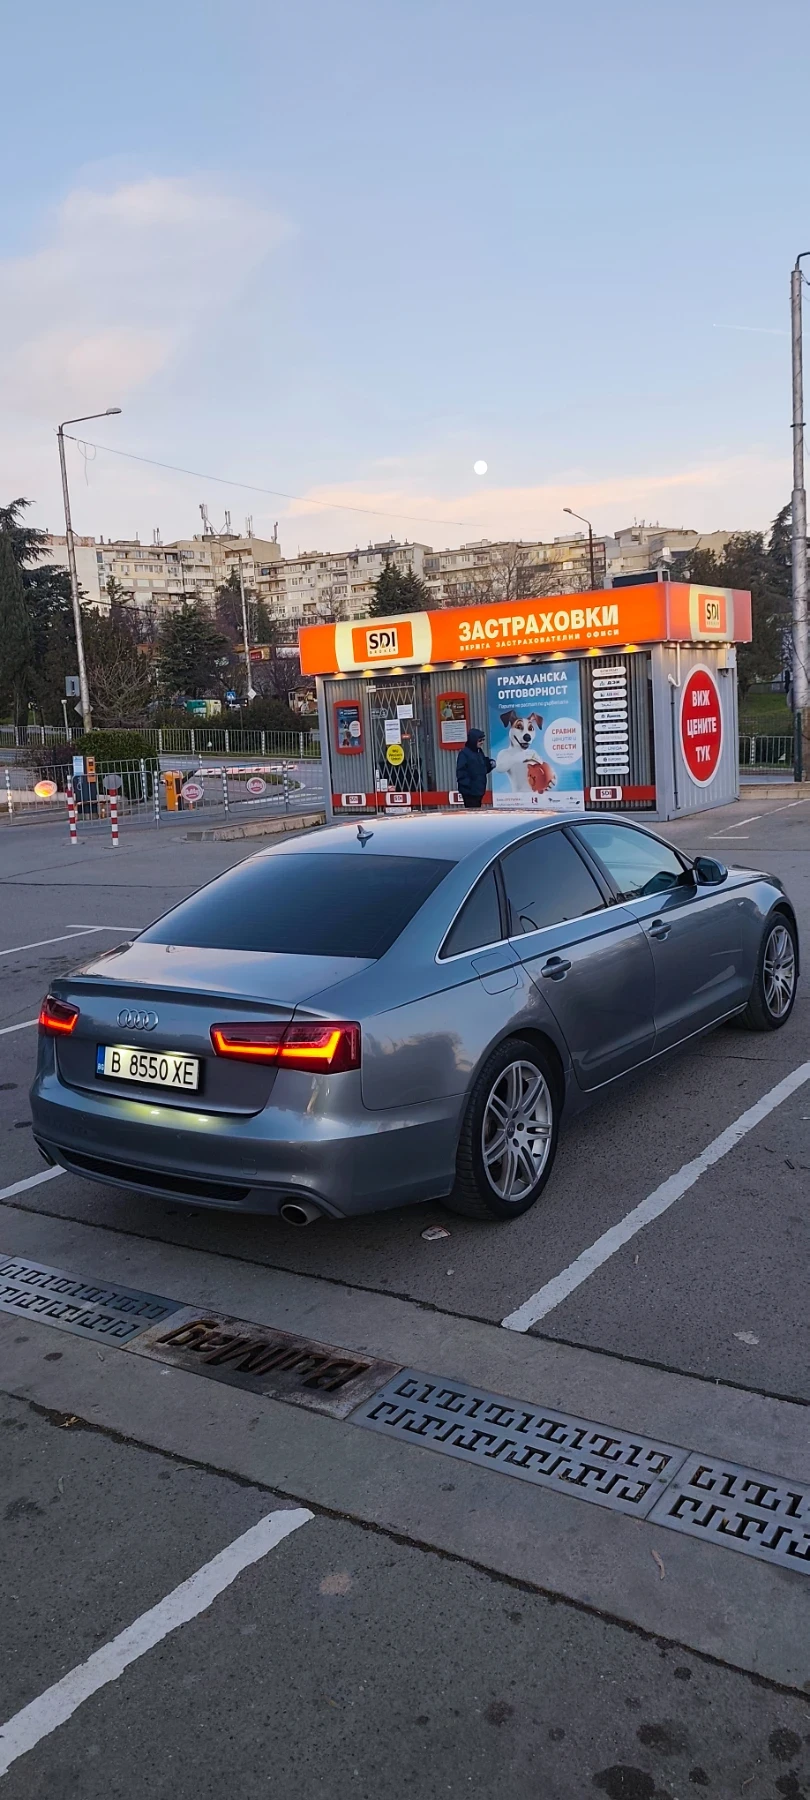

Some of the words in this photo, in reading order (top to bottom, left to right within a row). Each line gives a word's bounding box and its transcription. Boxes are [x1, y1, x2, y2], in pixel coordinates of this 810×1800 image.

[706, 602, 720, 621] SDI
[458, 604, 619, 643] ЗАСТРАХОВКИ
[369, 631, 396, 650] SDI
[459, 642, 491, 652] ВЕРИГА
[495, 633, 581, 648] ЗАСТРАХОВАТЕЛНИ
[586, 629, 619, 639] ОФИСИ
[497, 671, 568, 687] ГРАЖДАНСКА
[497, 685, 568, 700] ОТГОВОРНОСТ
[691, 689, 710, 707] ВИЖ
[551, 727, 576, 735] СРАВНИ
[686, 716, 717, 738] ЦЕНИТЕ
[552, 743, 577, 751] СПЕСТИ
[695, 745, 711, 762] ТУК
[111, 1052, 121, 1073] B
[129, 1055, 168, 1081] 8550
[172, 1060, 195, 1085] XE
[155, 1319, 372, 1393] BulMag
